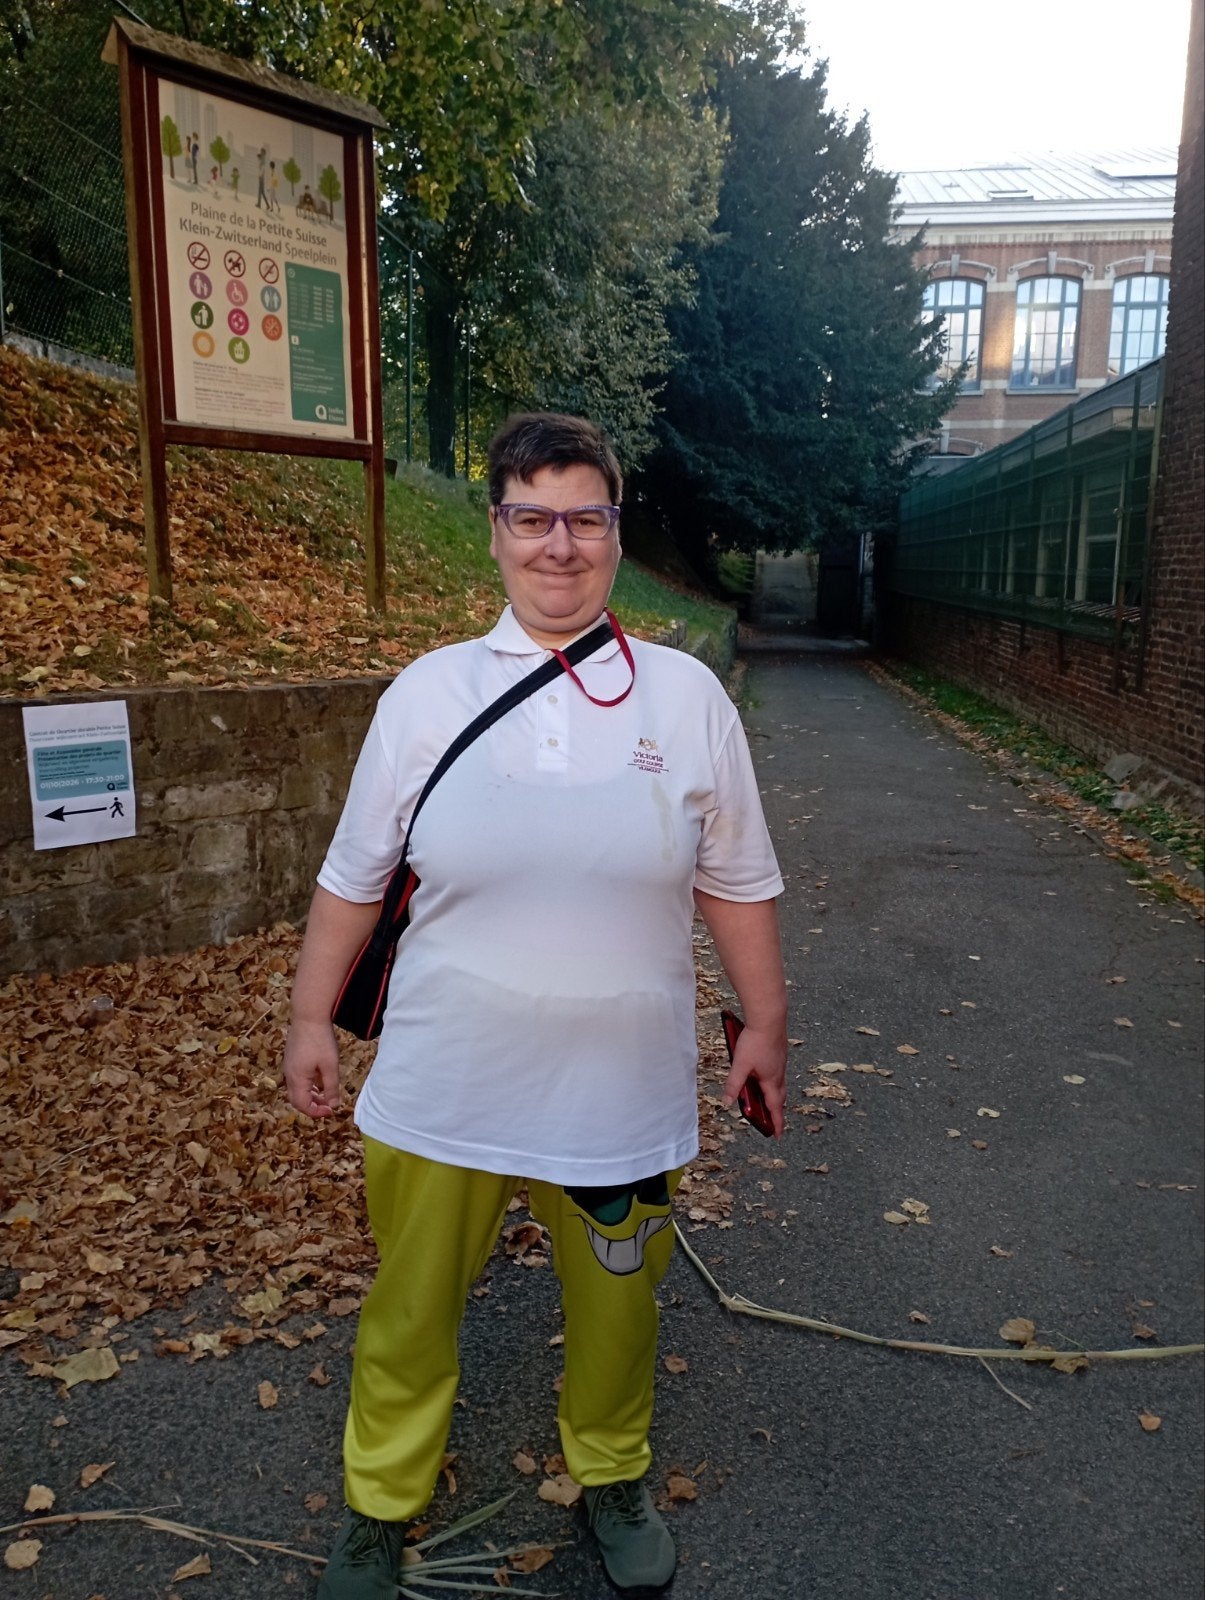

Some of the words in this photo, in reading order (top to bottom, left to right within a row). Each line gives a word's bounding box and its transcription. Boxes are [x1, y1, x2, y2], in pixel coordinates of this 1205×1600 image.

[179, 217, 282, 253] Klein-Zwitserland
[285, 243, 337, 266] Speelplein
[191, 202, 227, 222] Plaine
[229, 213, 244, 225] de
[246, 216, 256, 230] la
[259, 219, 293, 238] Petite
[295, 229, 327, 247] Suisse
[633, 751, 663, 762] Victoria
